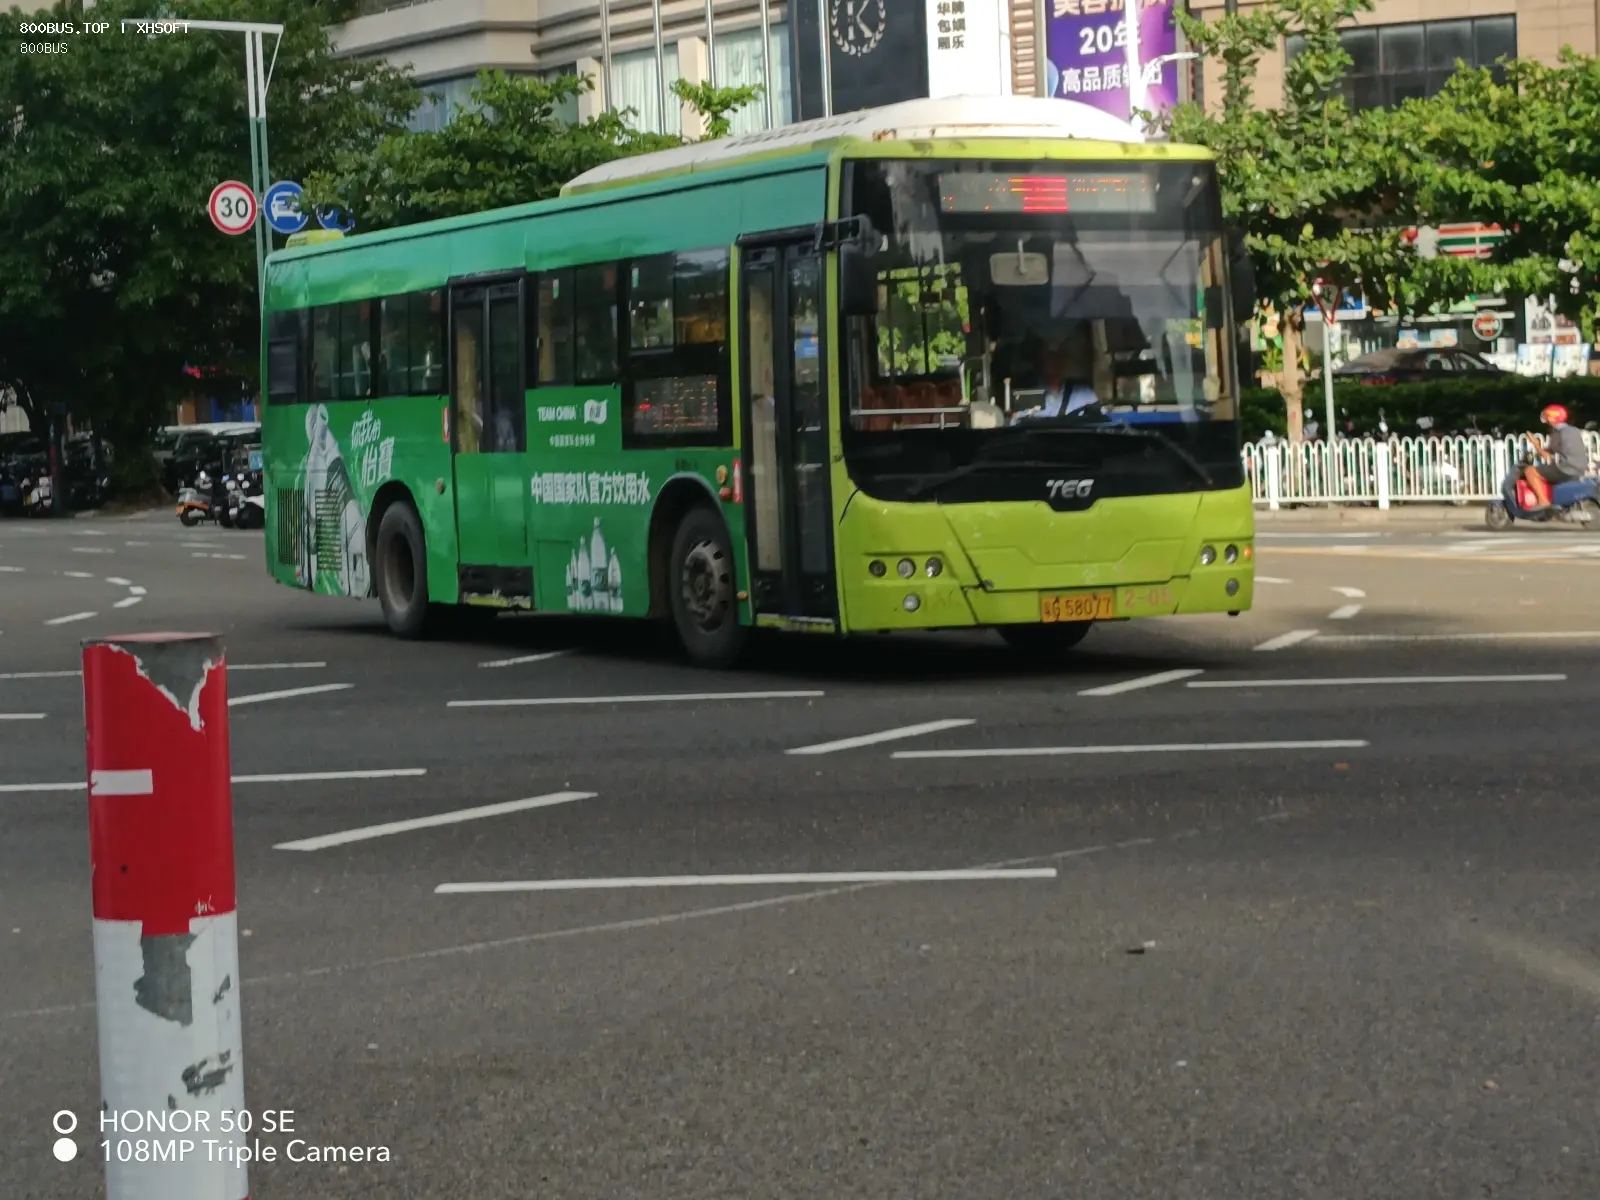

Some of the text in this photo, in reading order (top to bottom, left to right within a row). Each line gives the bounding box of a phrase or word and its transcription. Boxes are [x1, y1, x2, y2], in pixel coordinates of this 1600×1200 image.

[220, 196, 249, 219] 30
[531, 471, 650, 505] 中国国家队官方饮用水
[1046, 479, 1095, 499] TEG
